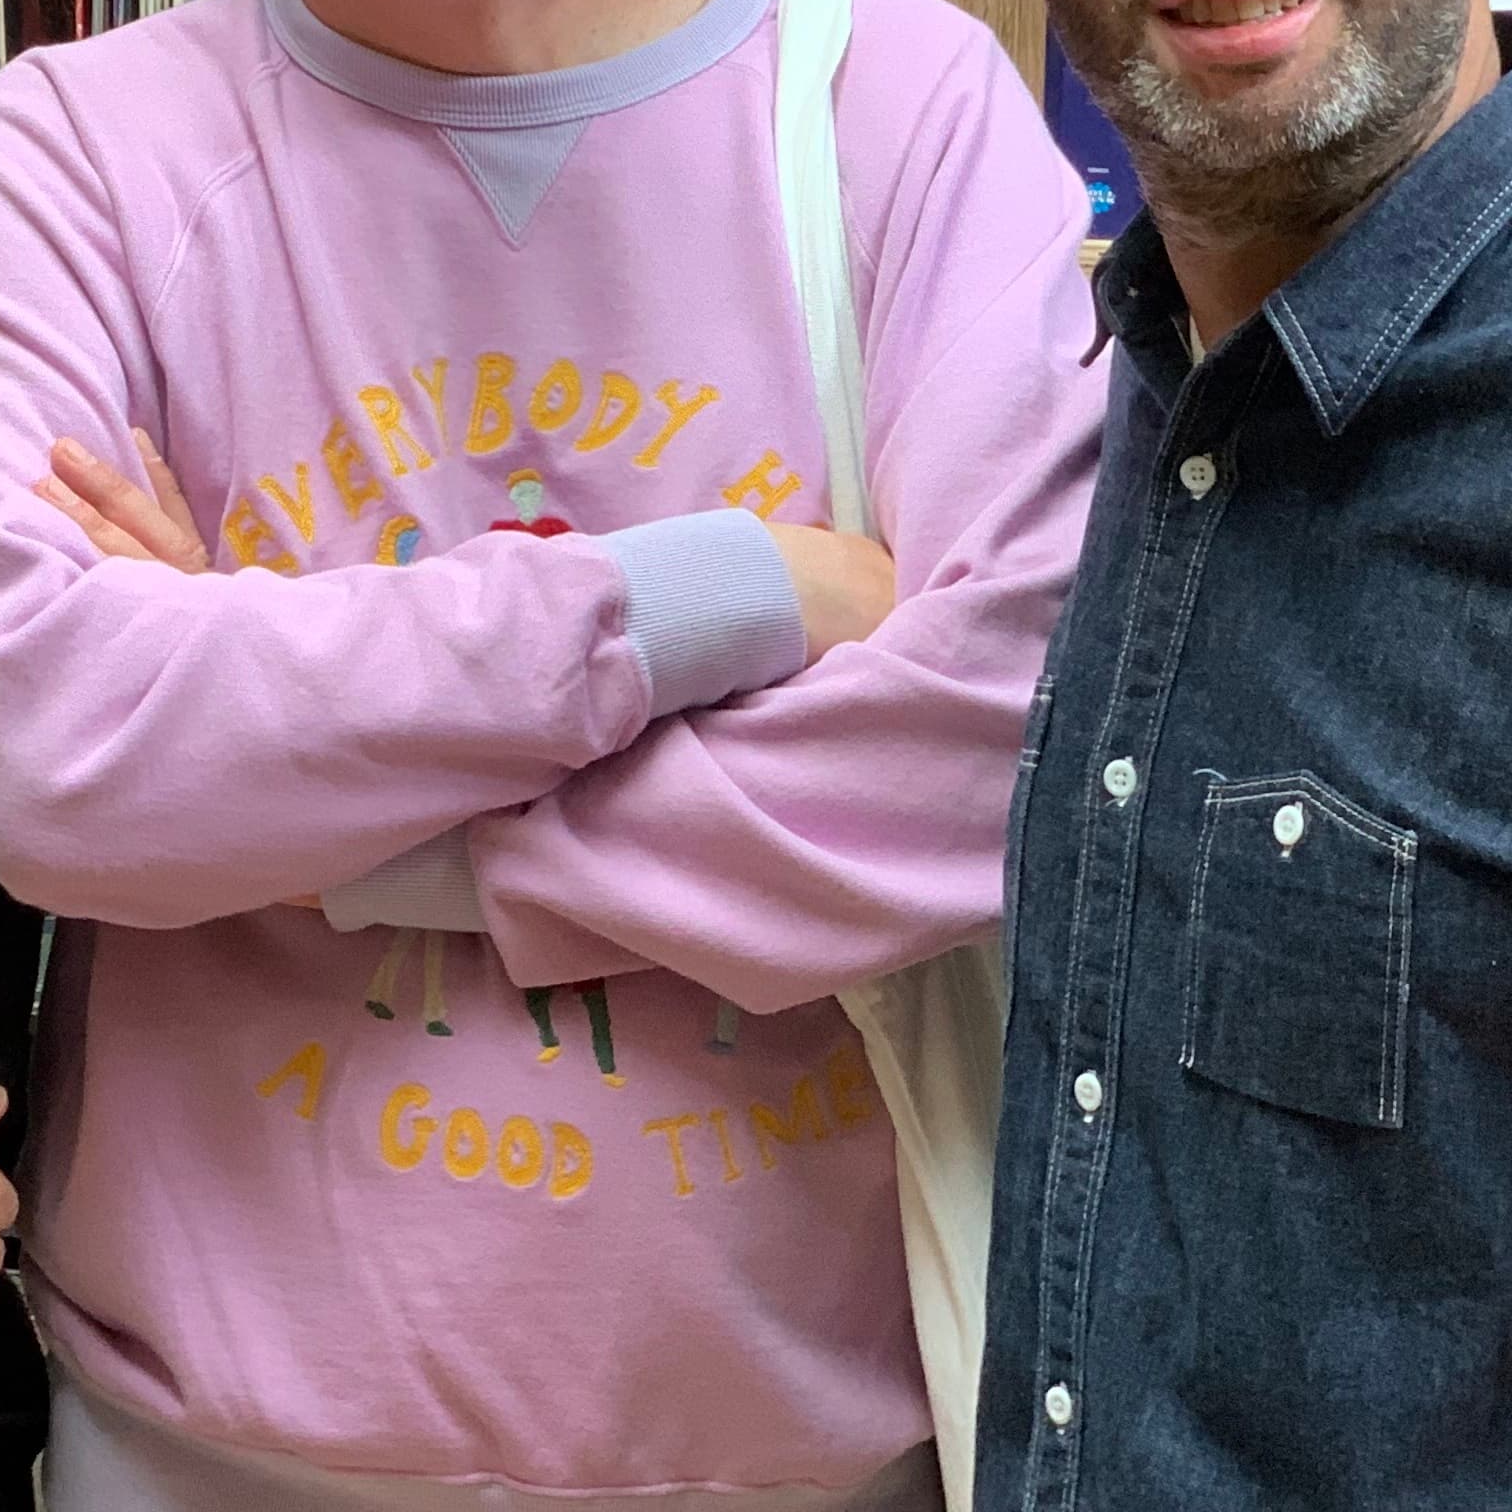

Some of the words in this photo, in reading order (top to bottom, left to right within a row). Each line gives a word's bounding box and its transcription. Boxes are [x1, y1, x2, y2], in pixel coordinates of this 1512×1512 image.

[224, 351, 721, 575] EVERYBODY
[254, 1041, 328, 1122] A
[381, 1083, 593, 1200] GOOD
[643, 1044, 875, 1197] TIME
